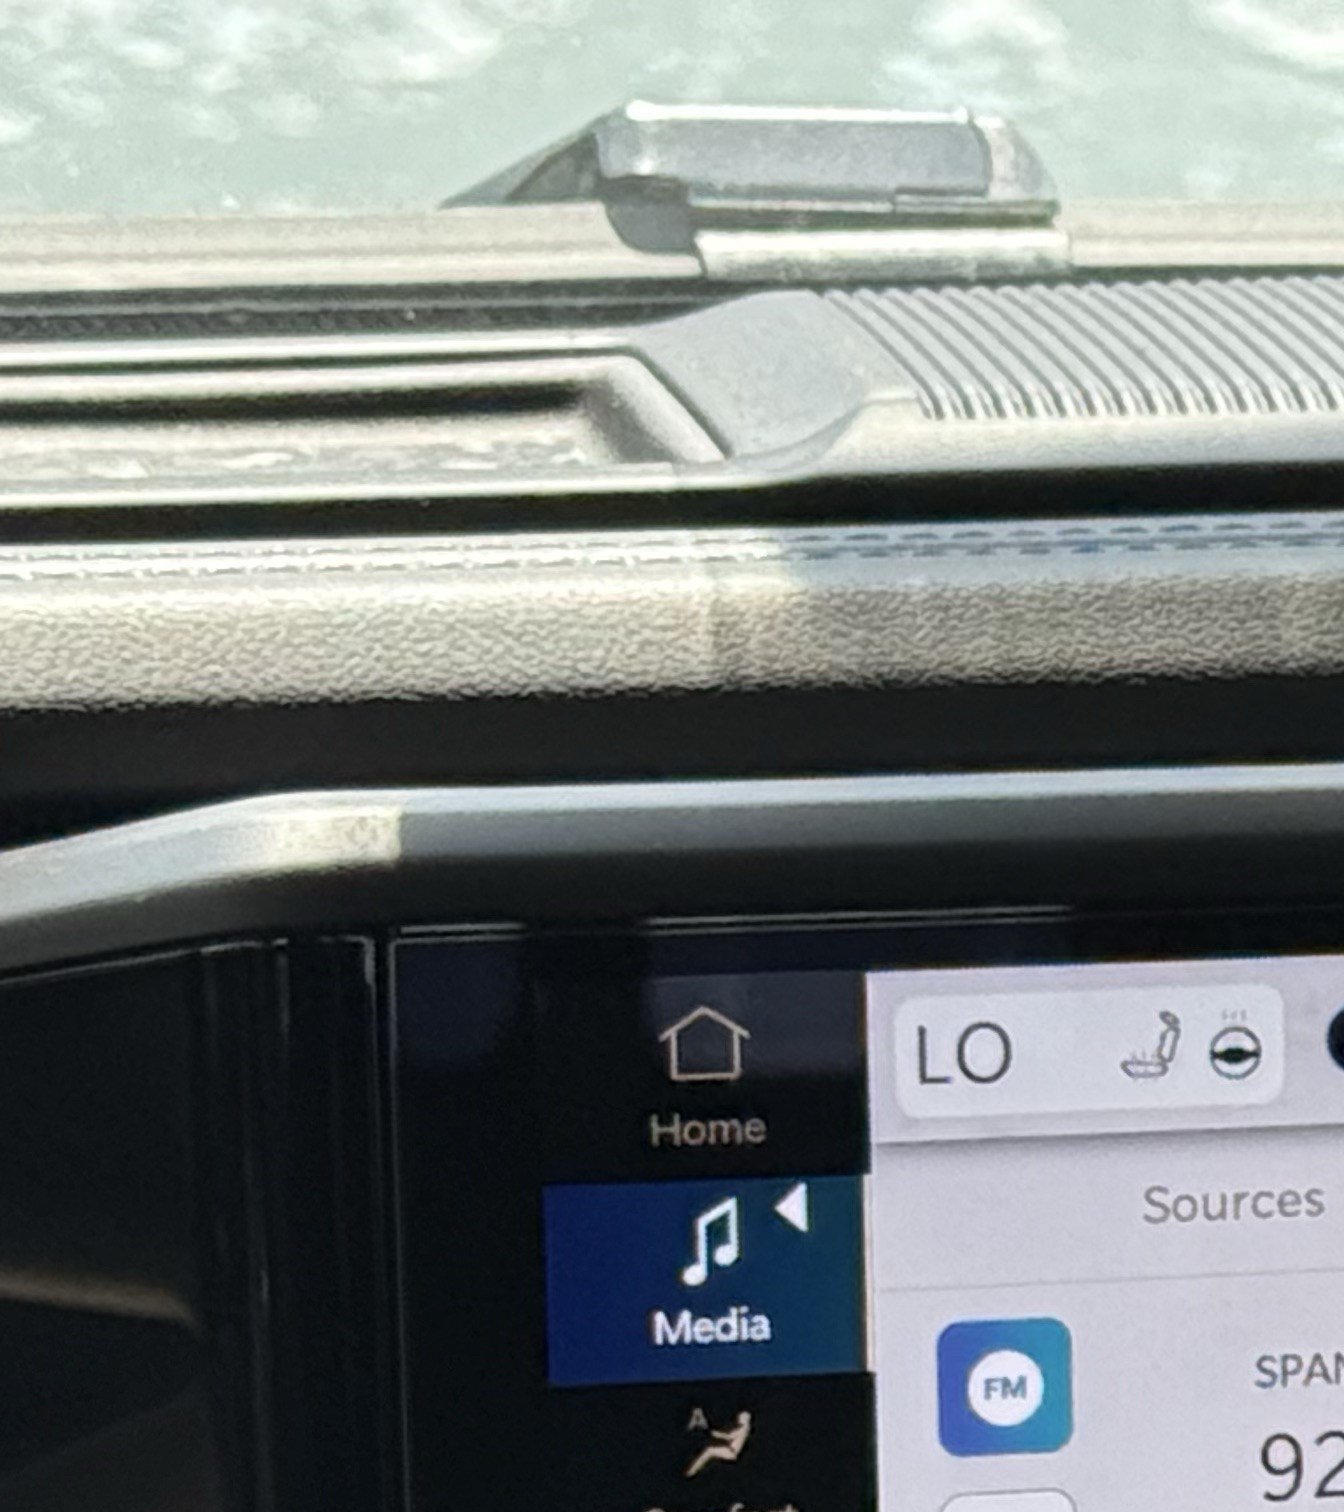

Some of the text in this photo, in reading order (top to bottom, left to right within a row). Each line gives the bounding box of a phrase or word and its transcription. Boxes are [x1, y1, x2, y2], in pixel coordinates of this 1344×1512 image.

[917, 1021, 1013, 1085] LO
[650, 1112, 767, 1147] Home
[1143, 1185, 1326, 1226] Sources
[652, 1308, 772, 1346] Media
[983, 1372, 1028, 1402] FM
